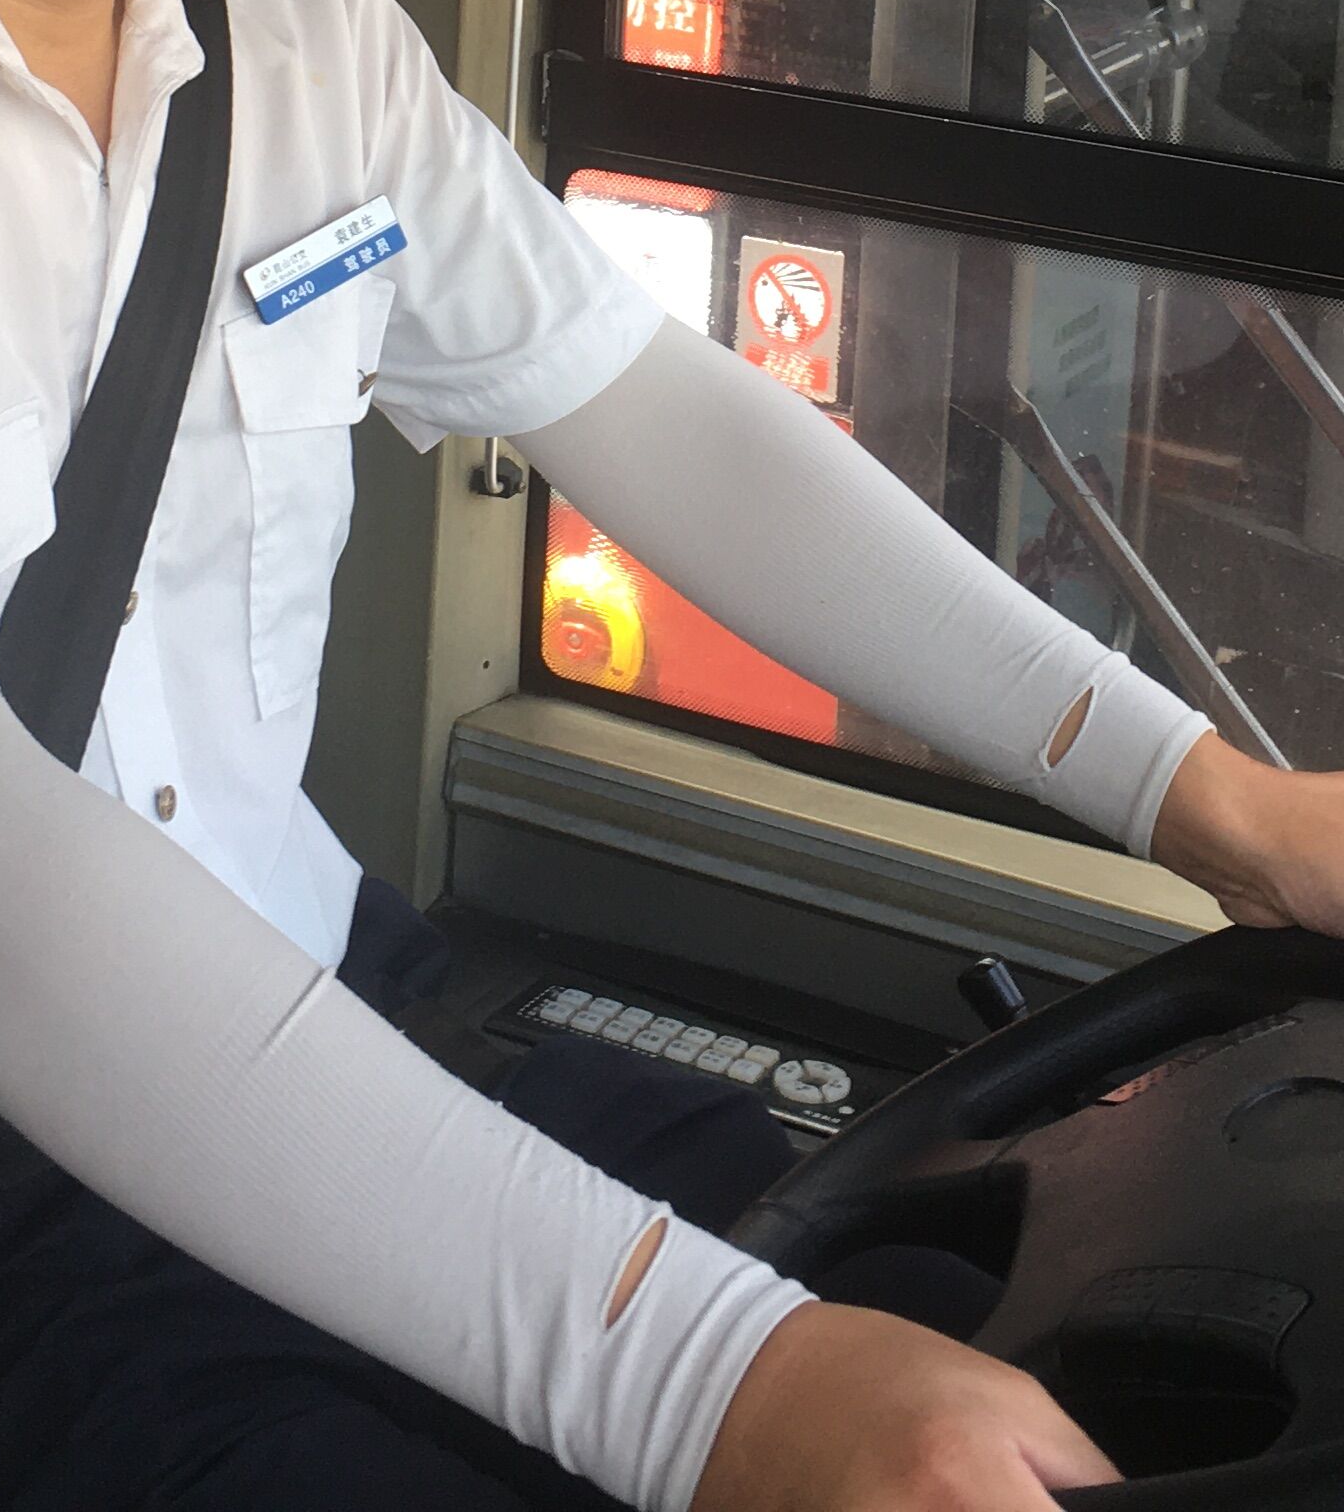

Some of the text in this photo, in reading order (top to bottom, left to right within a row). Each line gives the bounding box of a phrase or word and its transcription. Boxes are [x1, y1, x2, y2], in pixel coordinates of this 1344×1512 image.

[343, 237, 392, 273] 驾驶员
[281, 280, 315, 309] A240
